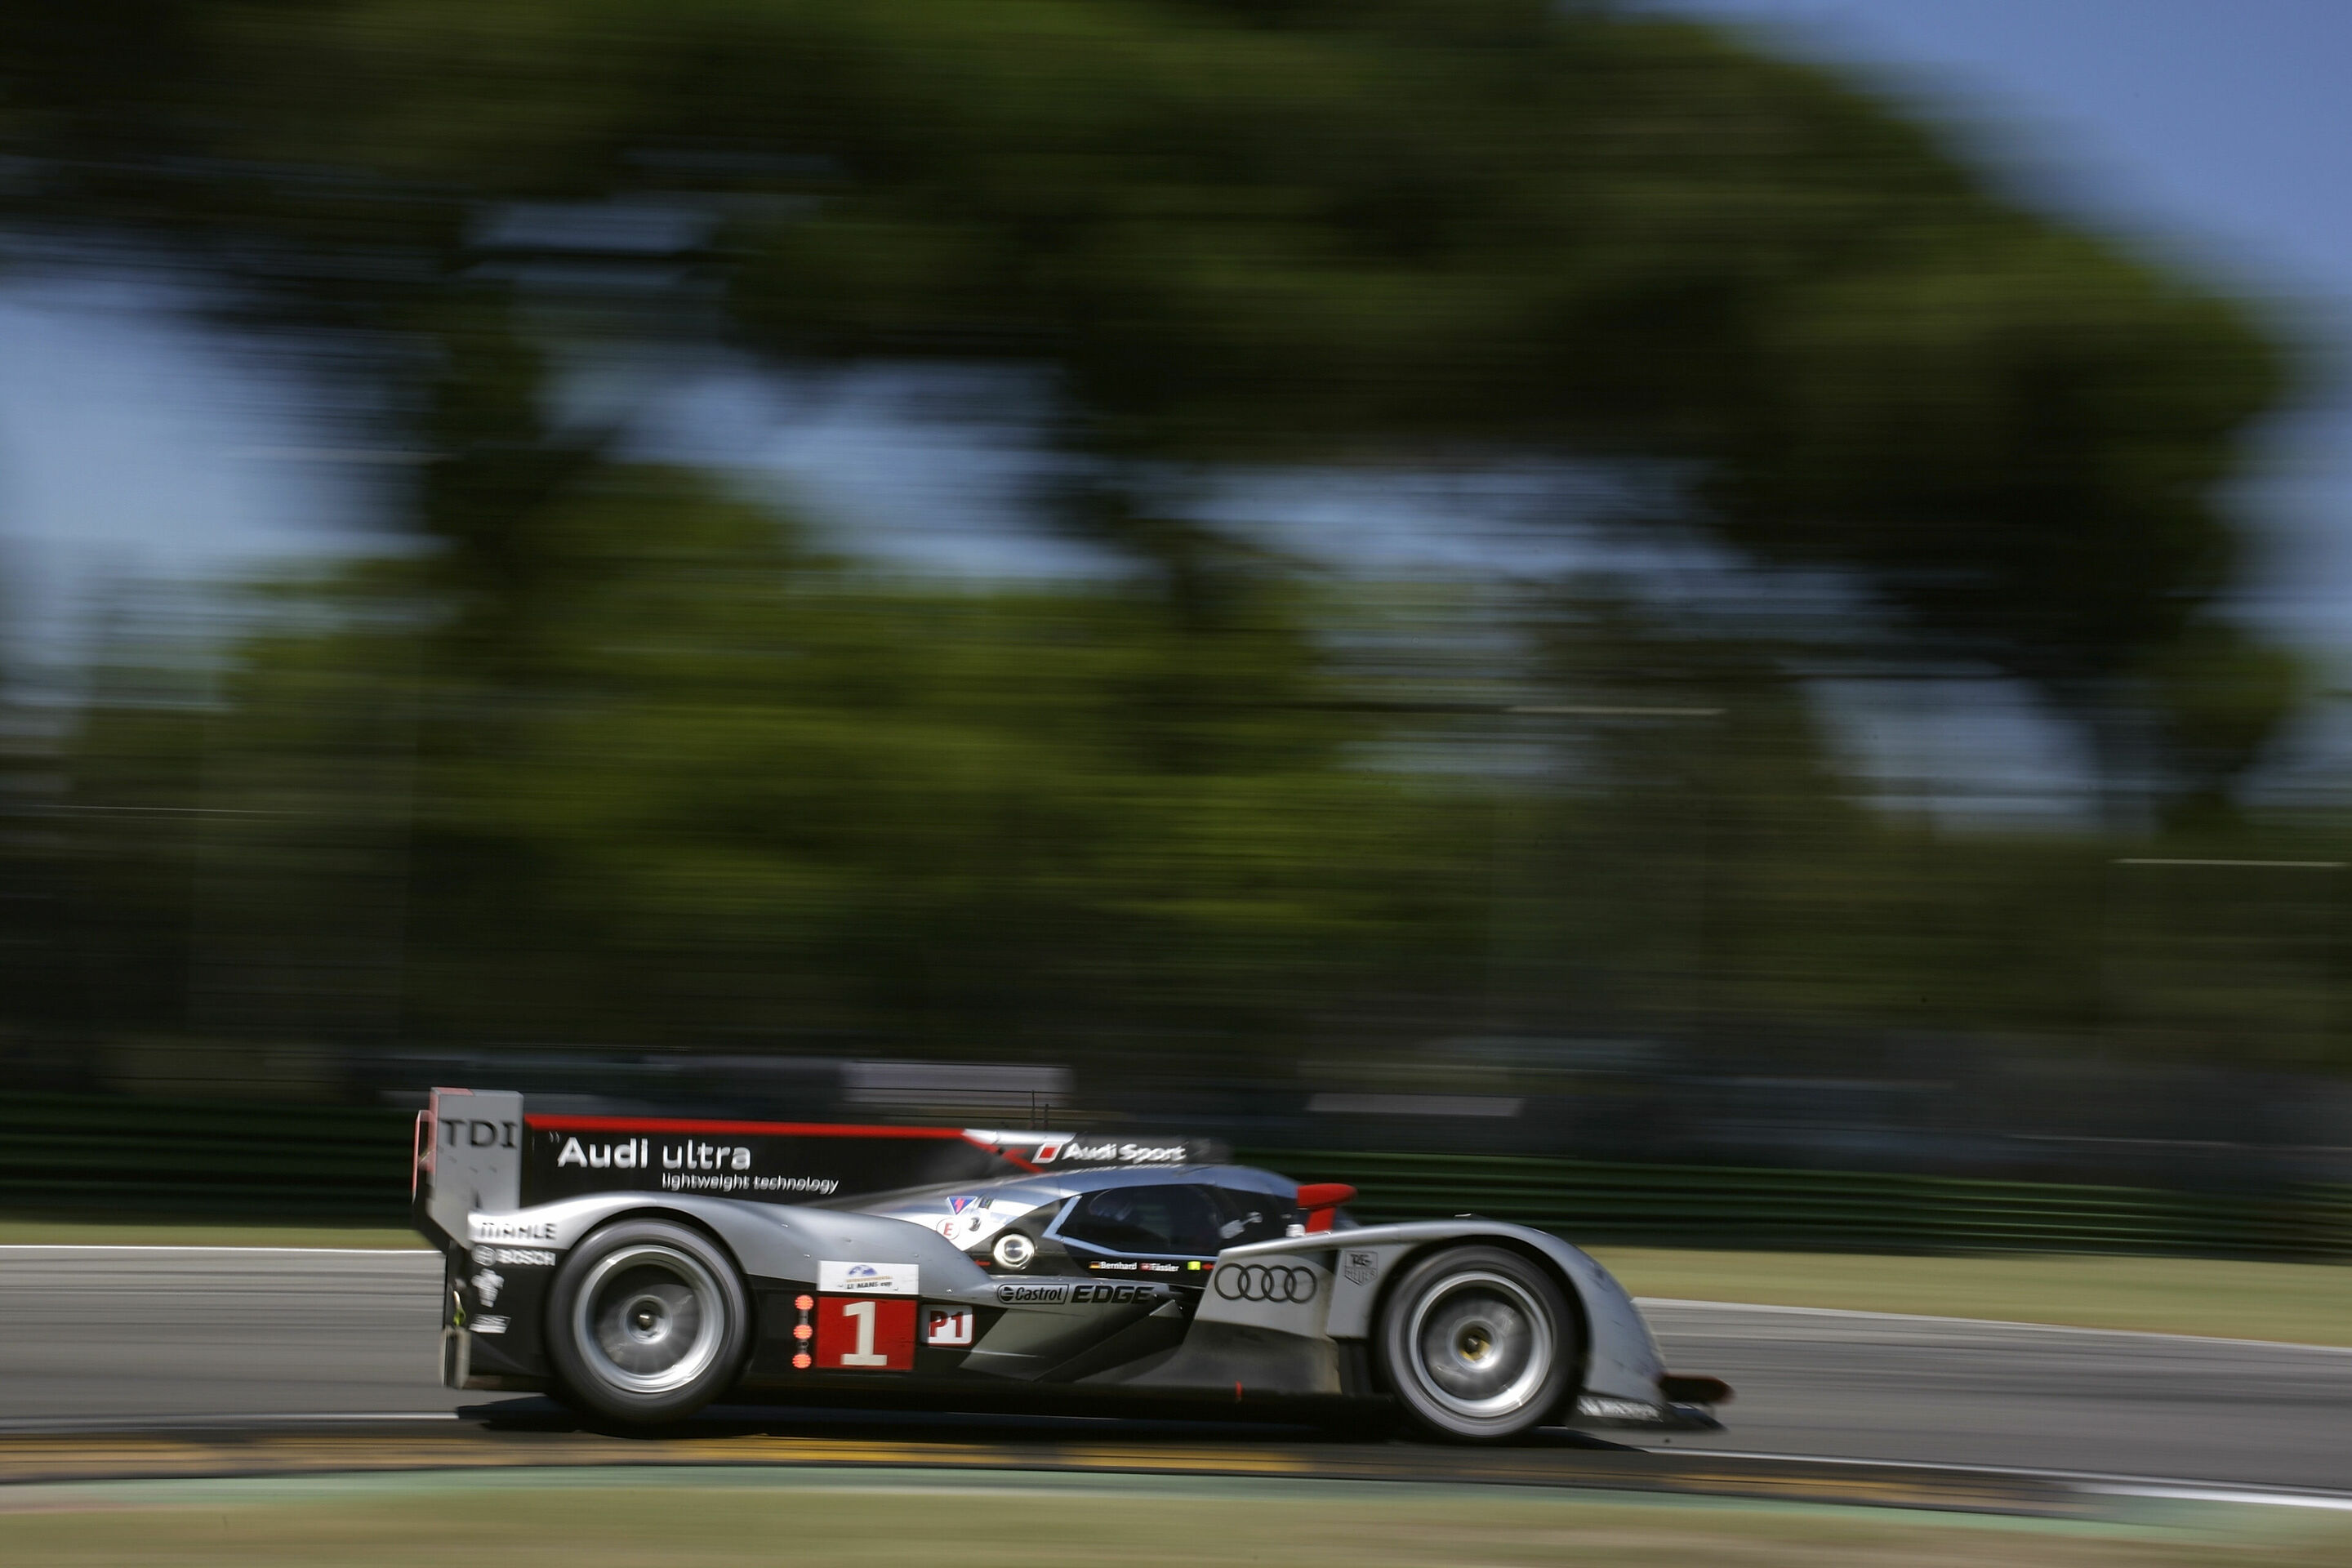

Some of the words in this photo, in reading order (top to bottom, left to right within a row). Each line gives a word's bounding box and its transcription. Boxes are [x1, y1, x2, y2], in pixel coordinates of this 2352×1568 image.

[439, 1119, 518, 1148] TDI
[557, 1136, 648, 1169] Audi
[662, 1138, 751, 1170] ultra
[1062, 1143, 1117, 1160] Audi
[1118, 1143, 1187, 1164] Sport
[662, 1172, 750, 1192] lightweight
[754, 1174, 839, 1195] technology
[1100, 1261, 1137, 1271] Bernhard
[1015, 1286, 1062, 1301] Castrol
[1071, 1285, 1155, 1303] EDGE
[840, 1300, 889, 1366] 1
[929, 1309, 964, 1339] P1
